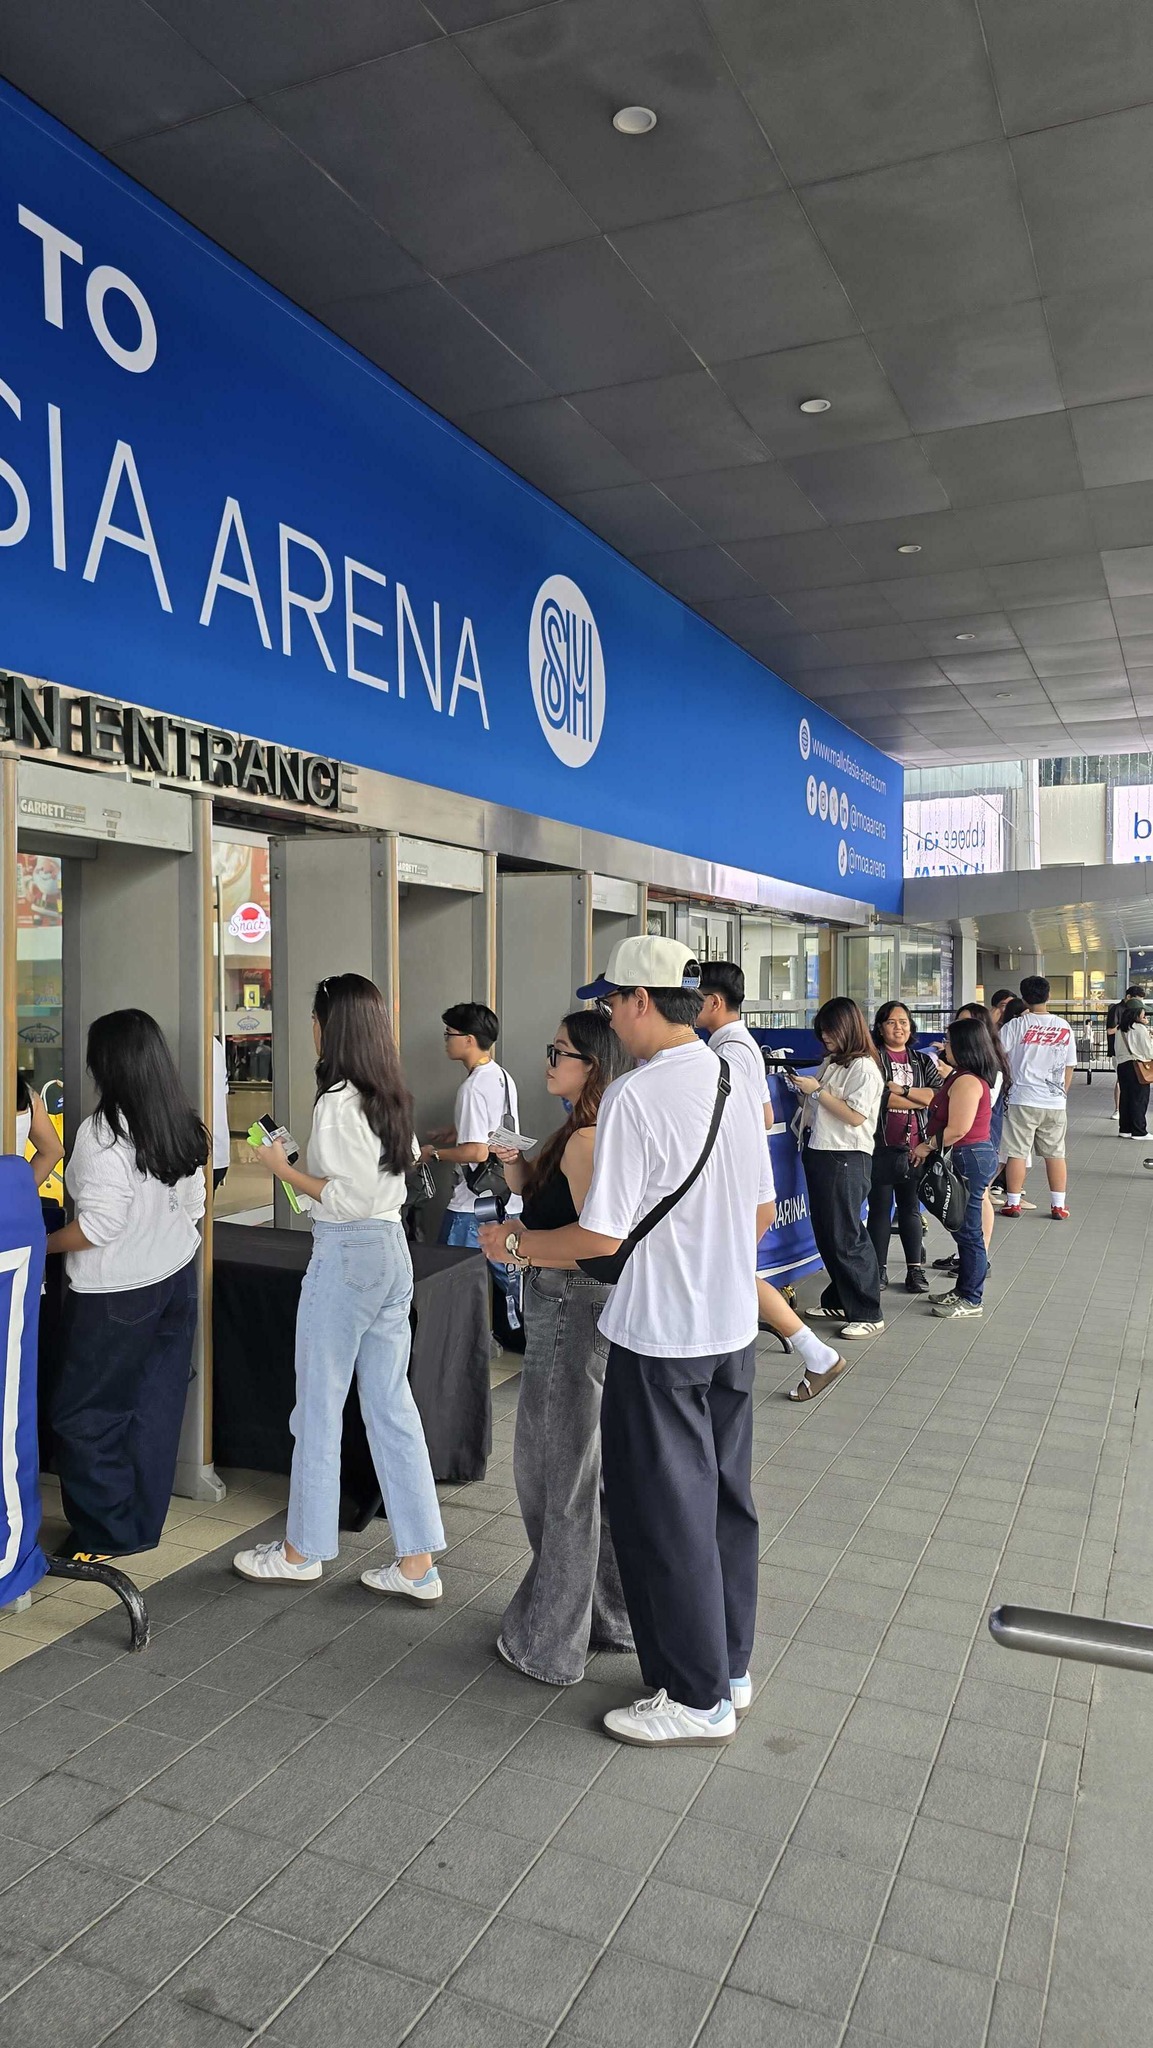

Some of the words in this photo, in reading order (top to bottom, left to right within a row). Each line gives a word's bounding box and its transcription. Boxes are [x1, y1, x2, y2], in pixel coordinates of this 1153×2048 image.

[18, 203, 157, 373] TO
[199, 495, 490, 730] ARENA
[541, 598, 592, 743] SM
[20, 799, 65, 818] GARRETT
[80, 696, 358, 813] ENTRANCE
[398, 862, 418, 874] ARRETT
